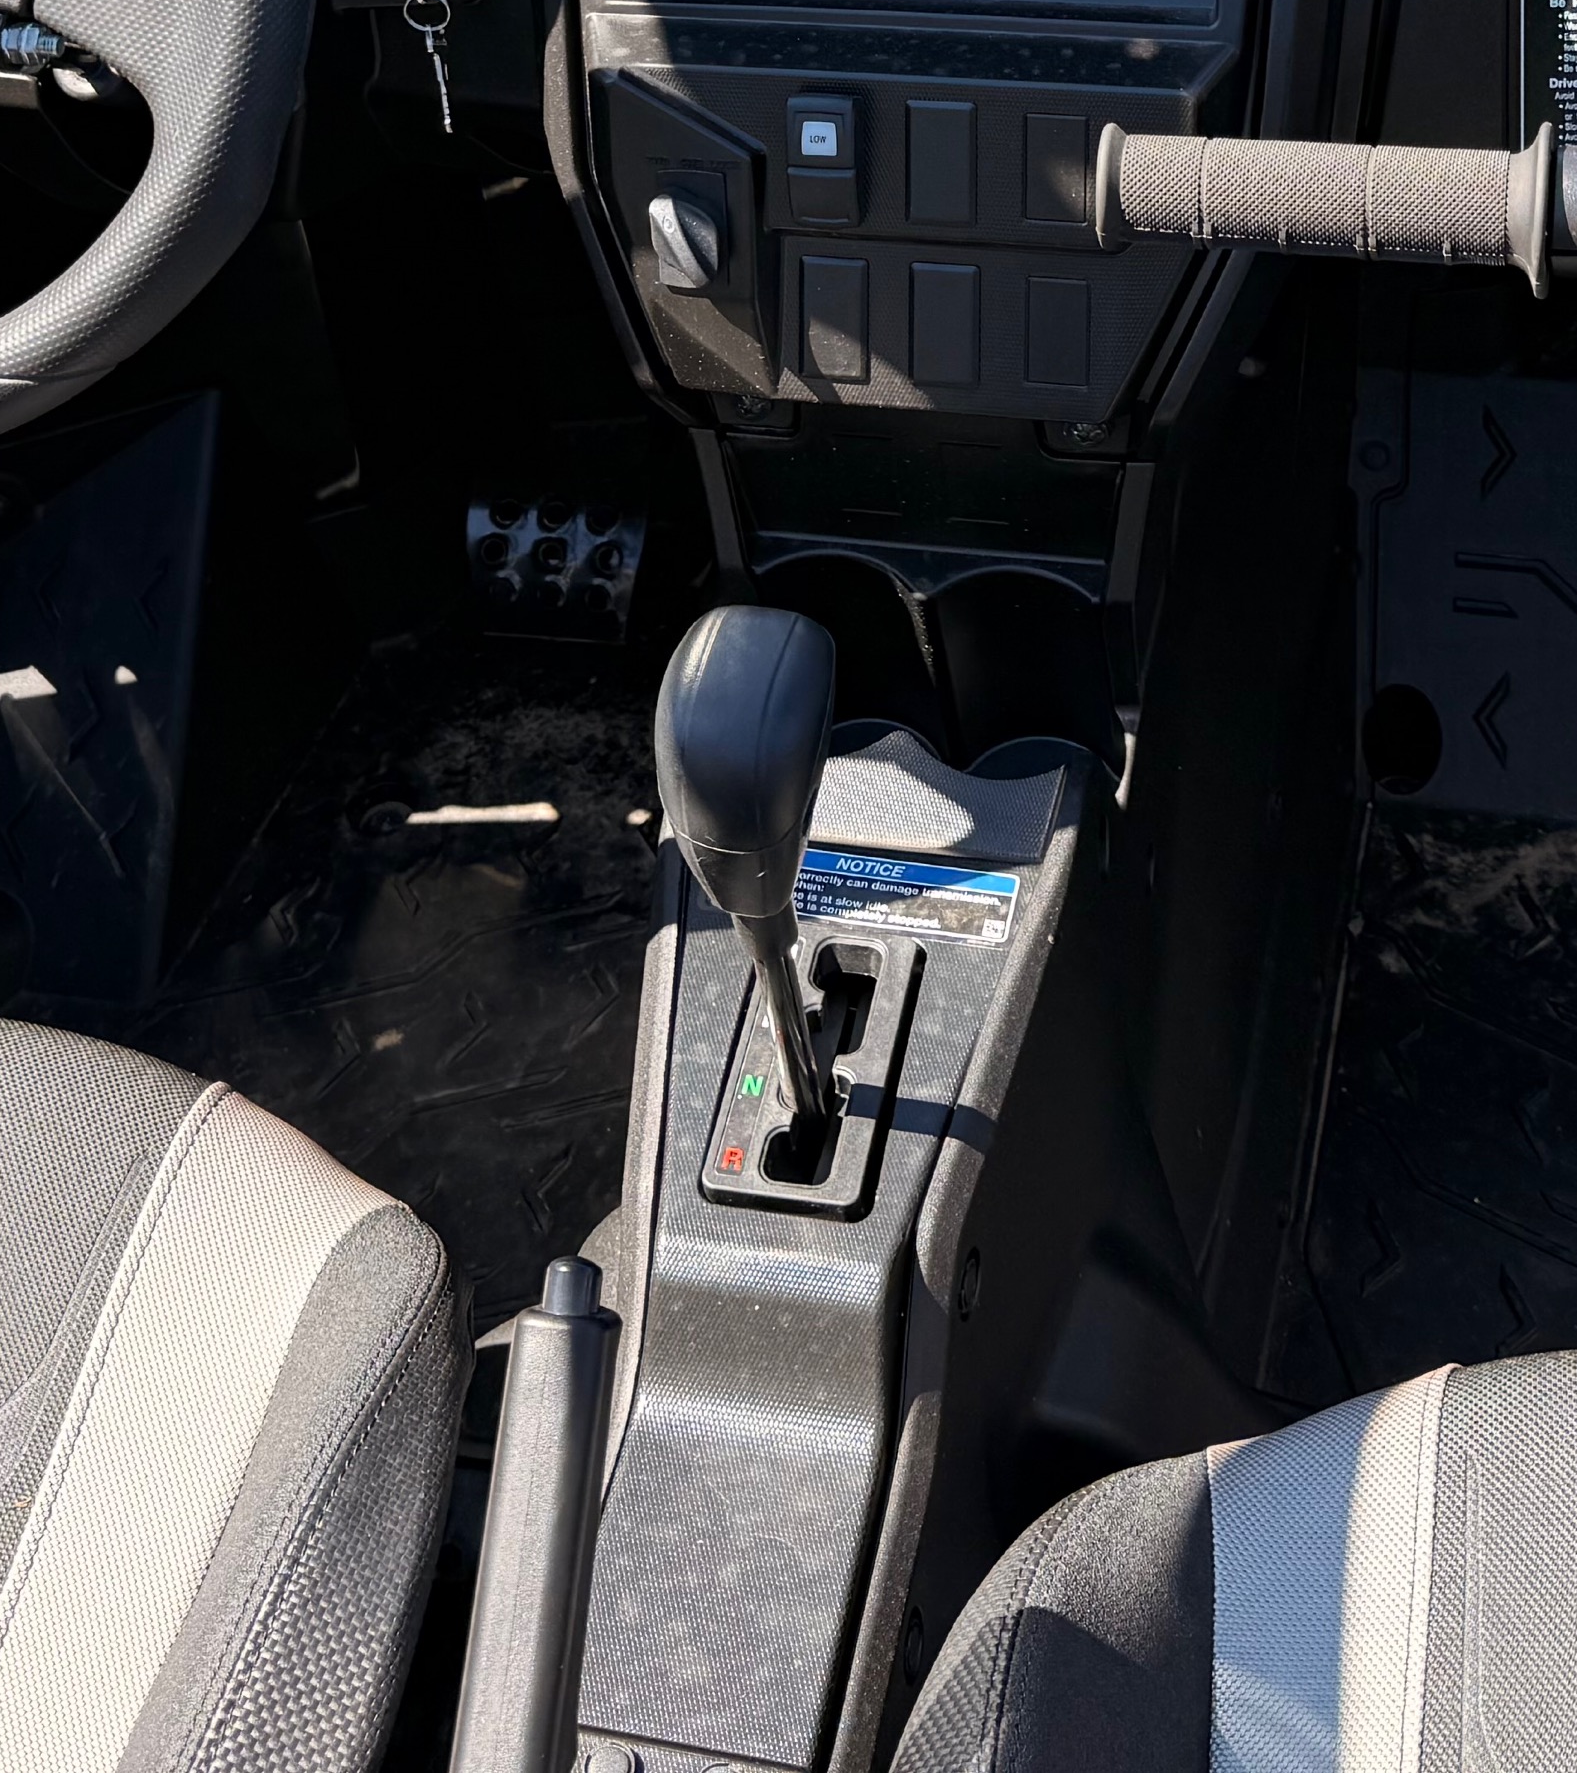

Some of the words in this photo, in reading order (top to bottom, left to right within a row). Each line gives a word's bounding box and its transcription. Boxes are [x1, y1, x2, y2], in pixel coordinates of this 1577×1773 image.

[809, 135, 827, 144] LOW
[836, 857, 906, 878] NOTICE
[799, 871, 844, 887] orrectly
[846, 878, 868, 889] can
[871, 881, 919, 896] damage
[807, 892, 818, 902] is
[820, 894, 832, 904] at
[835, 896, 863, 909] slow
[806, 901, 818, 911] is
[820, 904, 886, 924] completely
[741, 1074, 764, 1097] N
[720, 1147, 745, 1172] R
